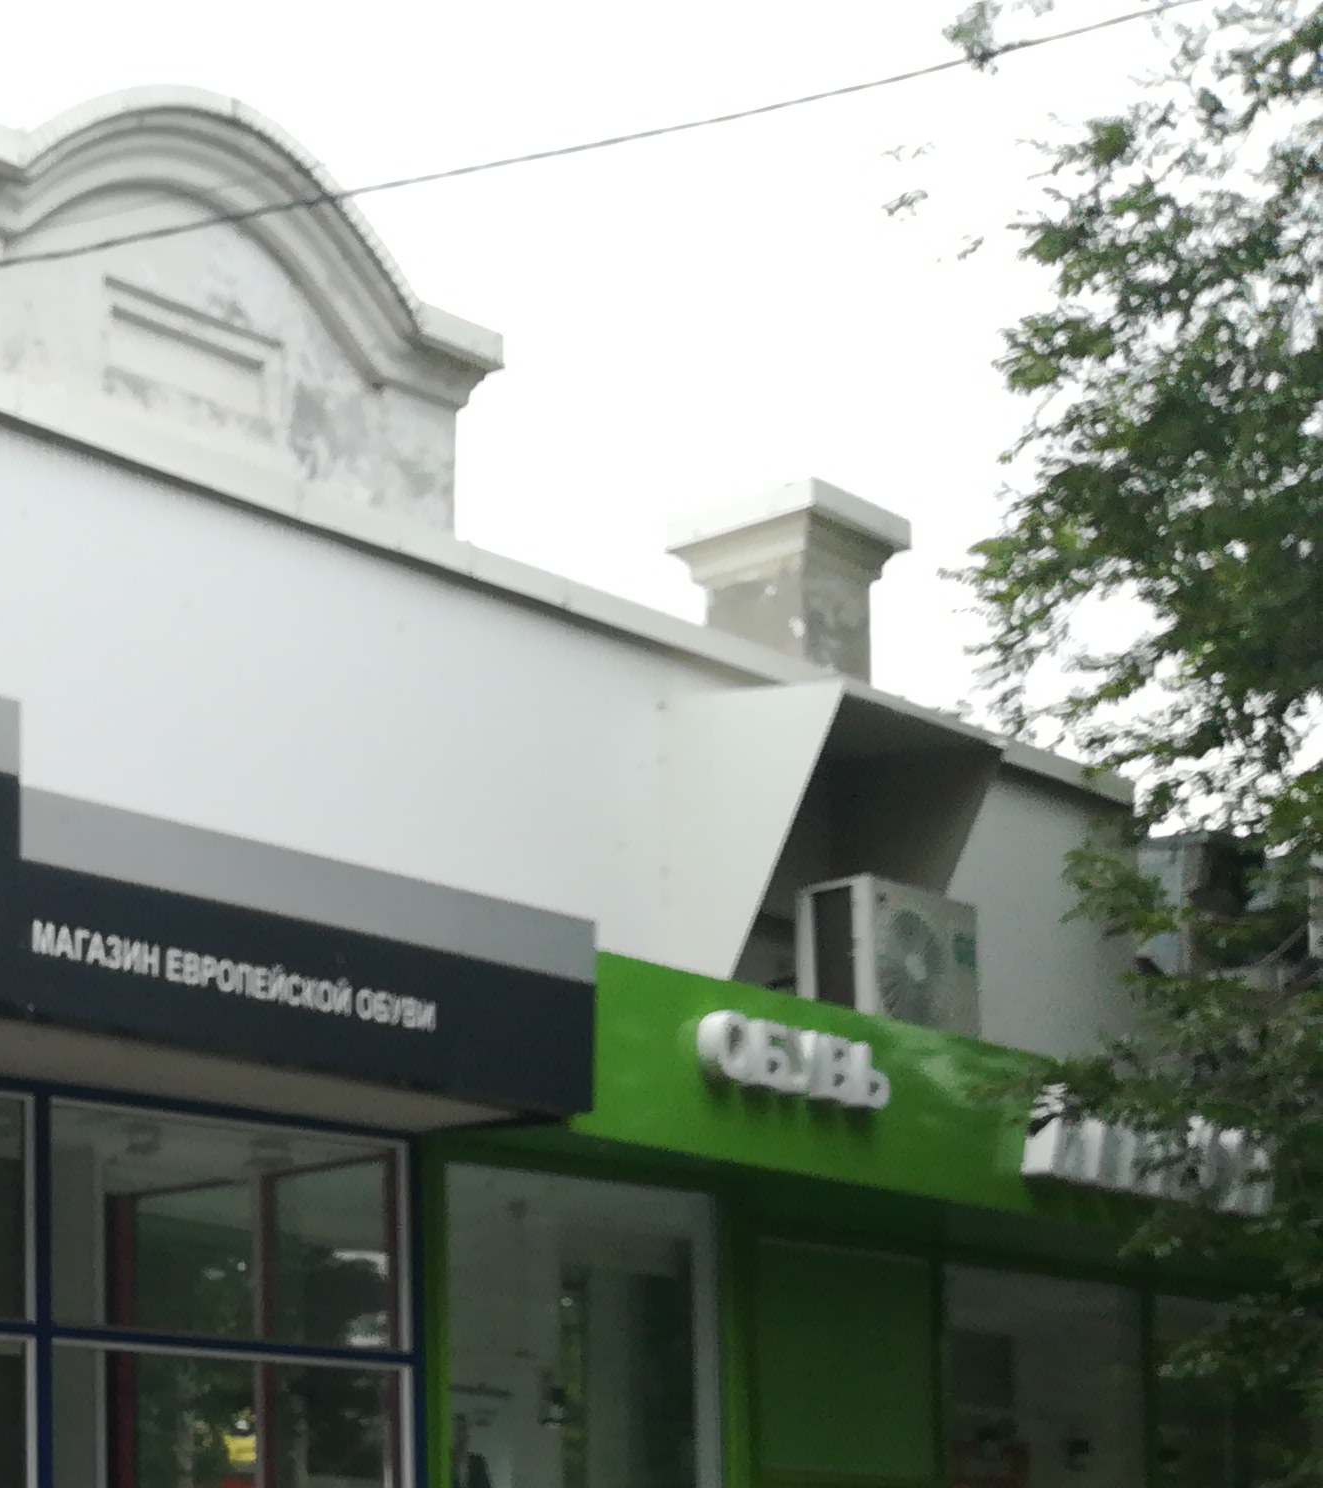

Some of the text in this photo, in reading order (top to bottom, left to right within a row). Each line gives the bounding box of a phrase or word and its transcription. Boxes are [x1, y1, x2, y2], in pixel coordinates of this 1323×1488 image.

[31, 917, 437, 1033] МАГАЗИН ЕВРОПЕЙСКОЙ ОБУВИ
[697, 1009, 891, 1110] ОБУВЬ
